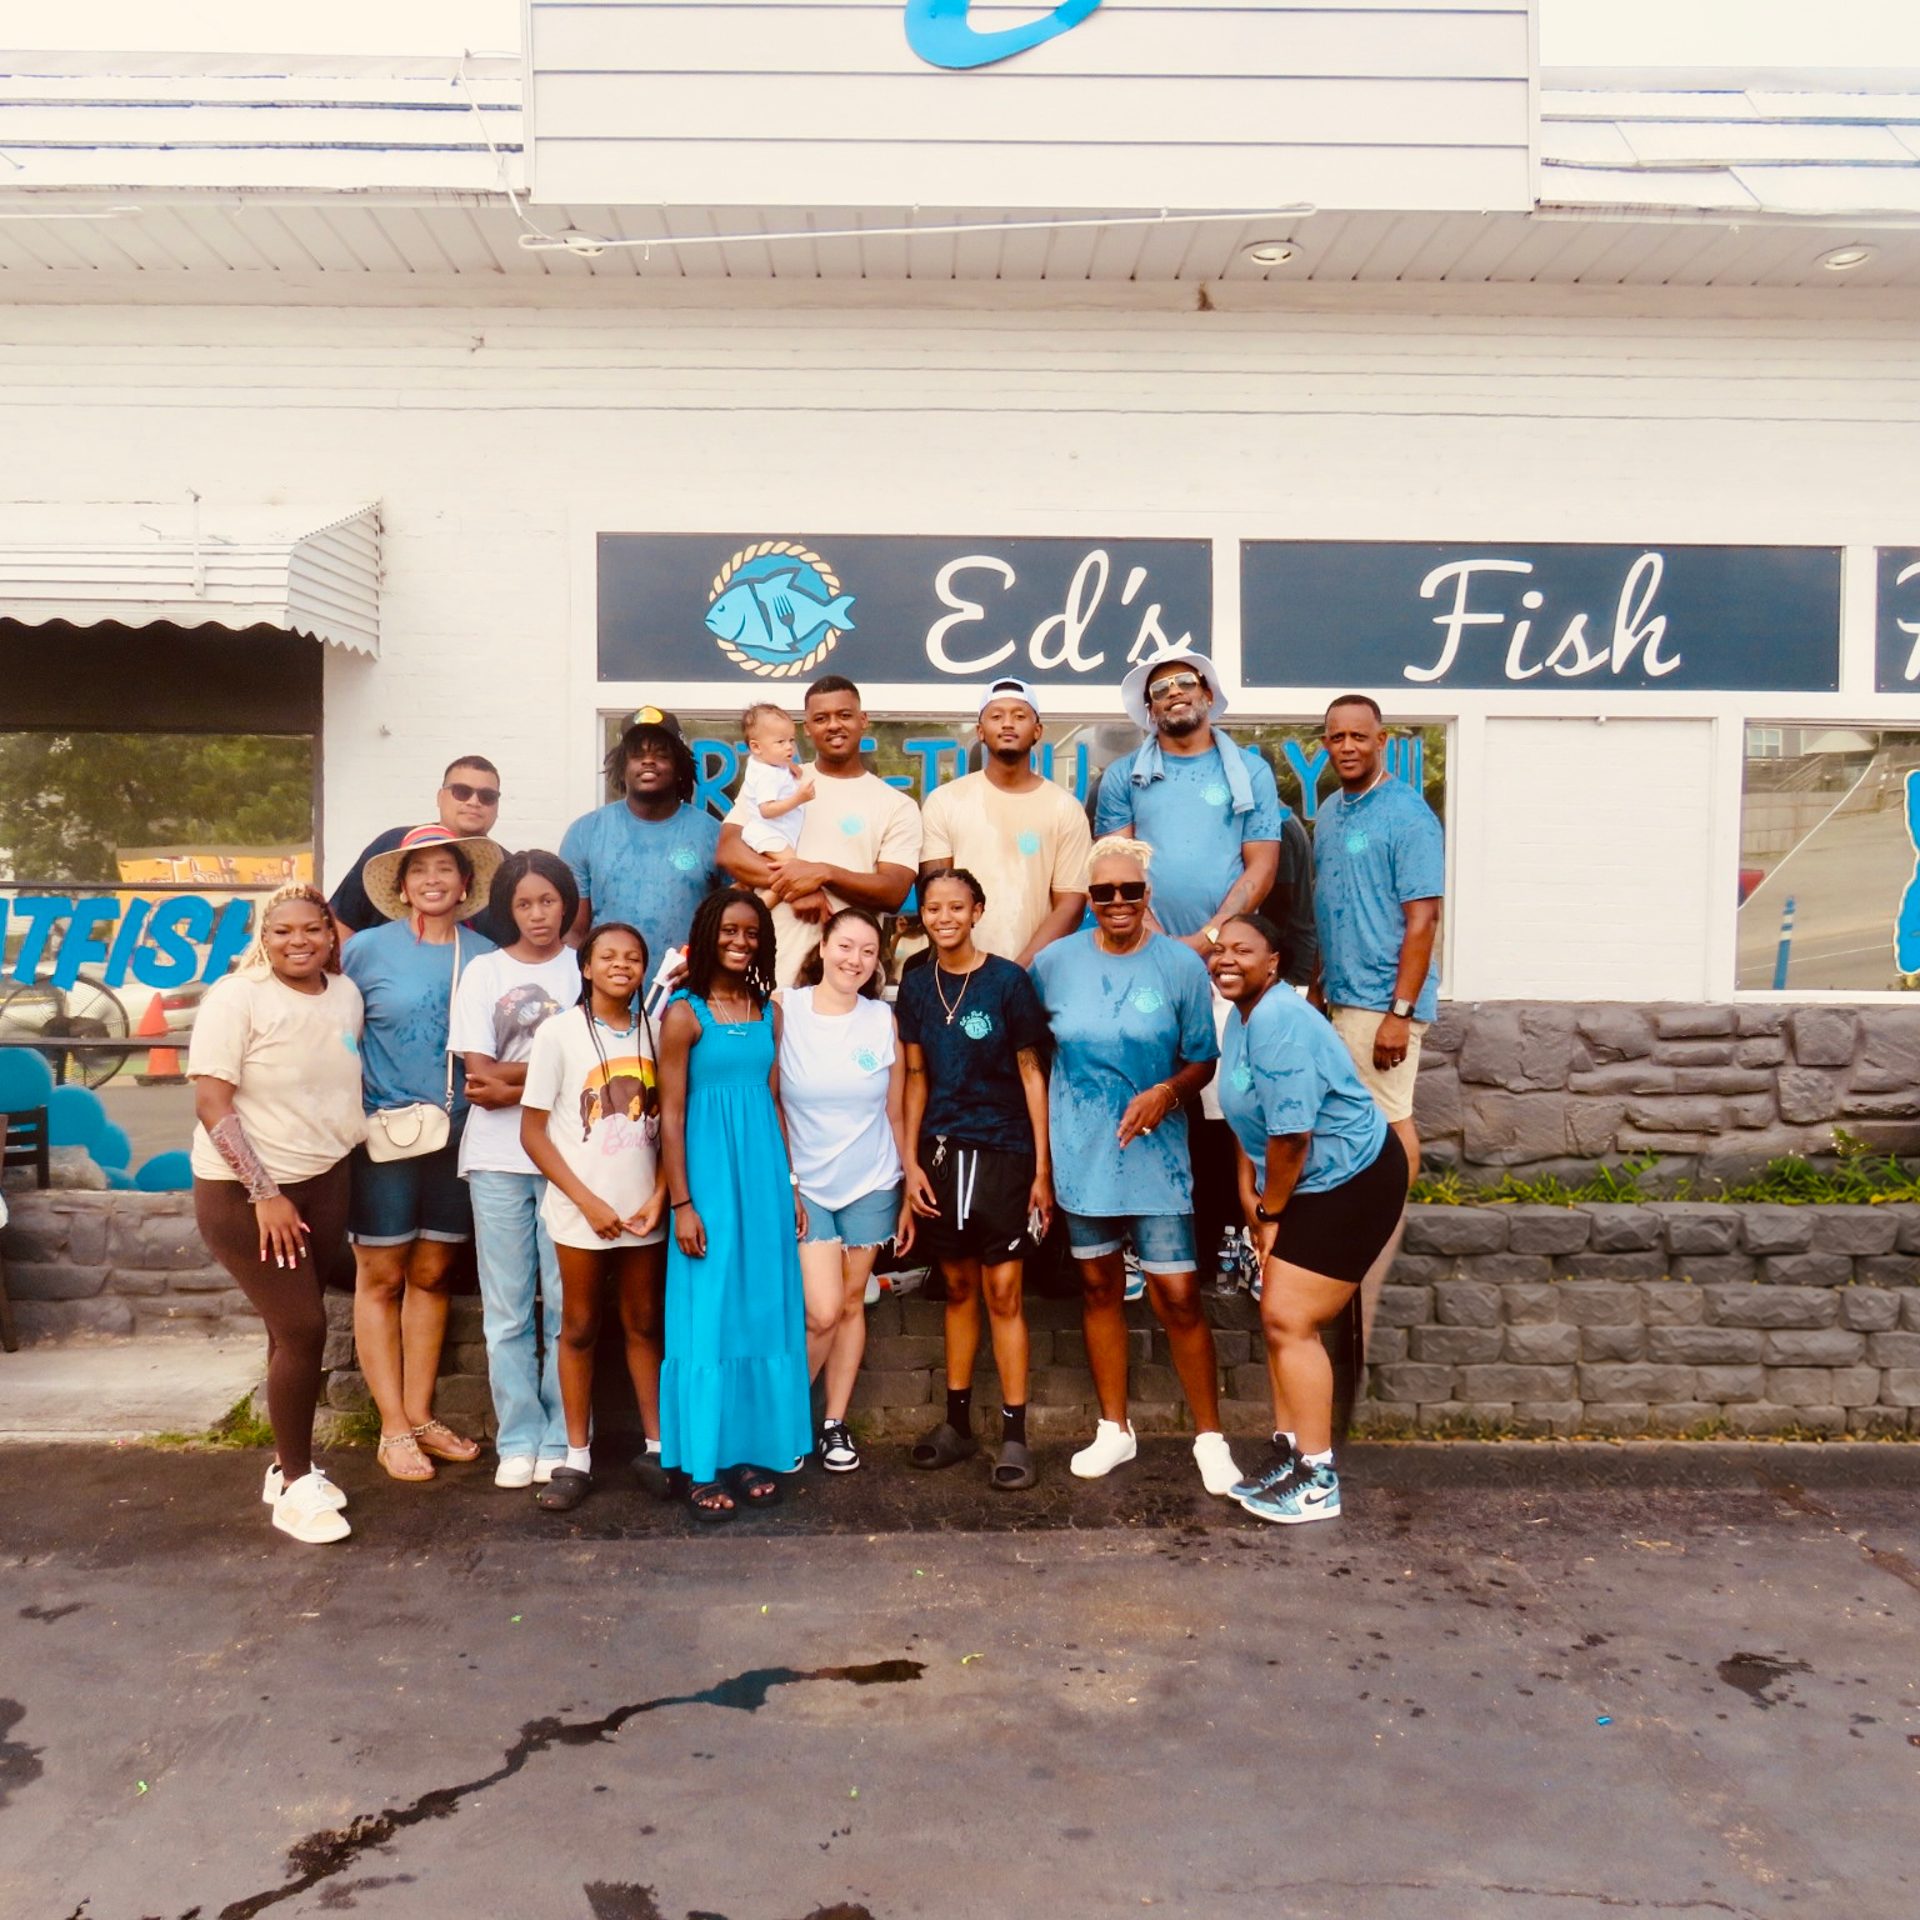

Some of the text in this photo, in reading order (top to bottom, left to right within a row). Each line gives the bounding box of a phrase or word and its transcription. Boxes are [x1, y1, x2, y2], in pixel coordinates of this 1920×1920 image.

[926, 550, 1681, 682] Ed's Fish
[0, 894, 255, 991] TFIS
